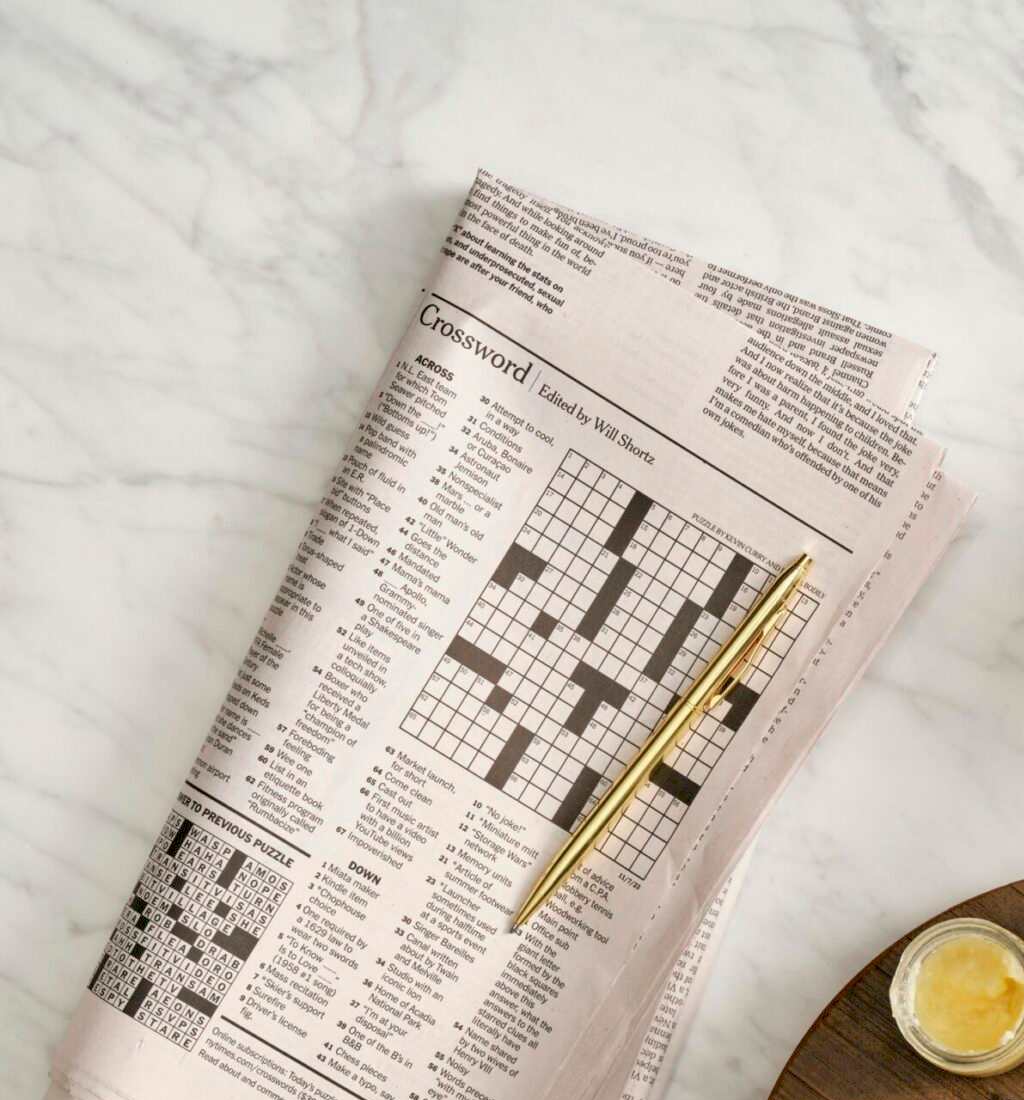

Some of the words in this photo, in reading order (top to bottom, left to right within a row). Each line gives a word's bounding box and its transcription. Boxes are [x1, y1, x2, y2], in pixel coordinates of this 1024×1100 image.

[453, 239, 471, 251] and
[536, 287, 566, 308] sexual
[460, 229, 485, 247] about
[483, 240, 518, 267] learning
[516, 259, 532, 274] the
[530, 270, 553, 286] stats
[551, 282, 564, 294] on
[455, 253, 470, 266] are
[469, 261, 491, 276] after
[487, 272, 510, 287] your
[535, 299, 554, 315] who
[696, 281, 718, 296] four
[720, 289, 734, 303] by
[735, 296, 763, 312] made
[711, 298, 743, 317] details
[745, 311, 765, 325] that
[765, 307, 815, 331] allegations
[419, 303, 534, 385] Crossword
[767, 319, 826, 349] investigation
[817, 327, 851, 345] assault
[852, 340, 884, 358] sexual
[413, 353, 455, 382] ACROSS
[828, 343, 879, 368] newspaper
[746, 336, 786, 364] audience
[783, 359, 809, 378] down
[807, 372, 823, 387] the
[852, 401, 873, 417] and
[869, 410, 877, 420] I
[874, 413, 901, 435] loved
[413, 395, 448, 419] pitched
[479, 394, 491, 405] 30
[489, 401, 525, 428] Attempt
[524, 421, 535, 433] to
[537, 382, 578, 416] Edited
[575, 406, 592, 426] by
[593, 415, 620, 442] Will
[616, 433, 656, 465] Shortz
[701, 406, 722, 423] own
[734, 355, 753, 371] was
[751, 366, 777, 386] about
[775, 379, 800, 401] harm
[799, 394, 845, 430] happening
[843, 423, 855, 434] to
[890, 451, 907, 466] Be-
[459, 424, 472, 436] 32
[499, 448, 533, 475] Bonaire
[466, 414, 478, 425] 31
[478, 420, 523, 454] Conditions
[707, 394, 725, 410] I'm
[722, 405, 731, 415] a
[729, 409, 771, 440] comedian
[770, 434, 796, 454] who's
[793, 450, 833, 478] offended
[830, 470, 844, 485] by
[842, 480, 860, 494] one
[858, 490, 871, 500] of
[867, 493, 882, 508] his
[714, 385, 744, 409] makes
[741, 403, 758, 417] me
[756, 410, 777, 429] hate
[806, 441, 842, 469] because
[840, 464, 860, 481] that
[858, 475, 888, 498] means
[466, 442, 478, 452] or
[476, 446, 512, 474] Curaçao
[435, 464, 447, 475] 35
[447, 470, 503, 511] Nonspecialist
[404, 515, 416, 526] 42
[445, 538, 478, 564] Wonder
[378, 556, 391, 567] 47
[390, 561, 424, 588] Mama's
[423, 584, 451, 605] mama
[359, 613, 368, 622] a
[366, 616, 422, 655] Shakespeare
[330, 661, 378, 695] colloquially
[311, 689, 343, 714] Liberty
[341, 707, 371, 730] Medal
[275, 722, 288, 733] 57
[287, 728, 336, 764] Foreboding
[384, 745, 396, 756] 63
[396, 750, 427, 775] Market
[244, 774, 256, 785] 62
[256, 779, 288, 804] Fitness
[286, 800, 324, 826] program
[359, 786, 371, 797] 66
[370, 791, 391, 810] First
[390, 805, 417, 825] music
[416, 821, 440, 839] artist
[189, 799, 202, 813] TO
[200, 807, 253, 844] PREVIOUS
[251, 837, 295, 869] PUZZLE
[335, 825, 347, 836] 67
[346, 830, 404, 870] Impoverished
[354, 819, 390, 848] YouTube
[389, 843, 414, 862] views
[457, 822, 469, 833] 12
[327, 862, 352, 884] Miata
[352, 879, 381, 900] maker
[347, 860, 382, 886] DOWN
[443, 870, 479, 895] summer
[477, 890, 515, 916] footwear
[400, 914, 413, 926] 30
[412, 920, 441, 942] Singer
[536, 909, 559, 928] Main
[556, 923, 579, 942] point
[258, 961, 267, 970] 6
[265, 963, 289, 984] Mass
[288, 979, 329, 1007] recitation
[505, 959, 529, 979] black
[527, 975, 559, 999] squares
[238, 993, 246, 1002] 9
[244, 996, 278, 1021] Driver's
[277, 1014, 308, 1039] license
[367, 992, 404, 1019] National
[401, 1012, 422, 1031] Park
[322, 1040, 334, 1052] 41
[334, 1046, 361, 1067] Chess
[359, 1063, 388, 1083] pieces
[426, 1061, 439, 1073] 56
[439, 1066, 466, 1089] Words
